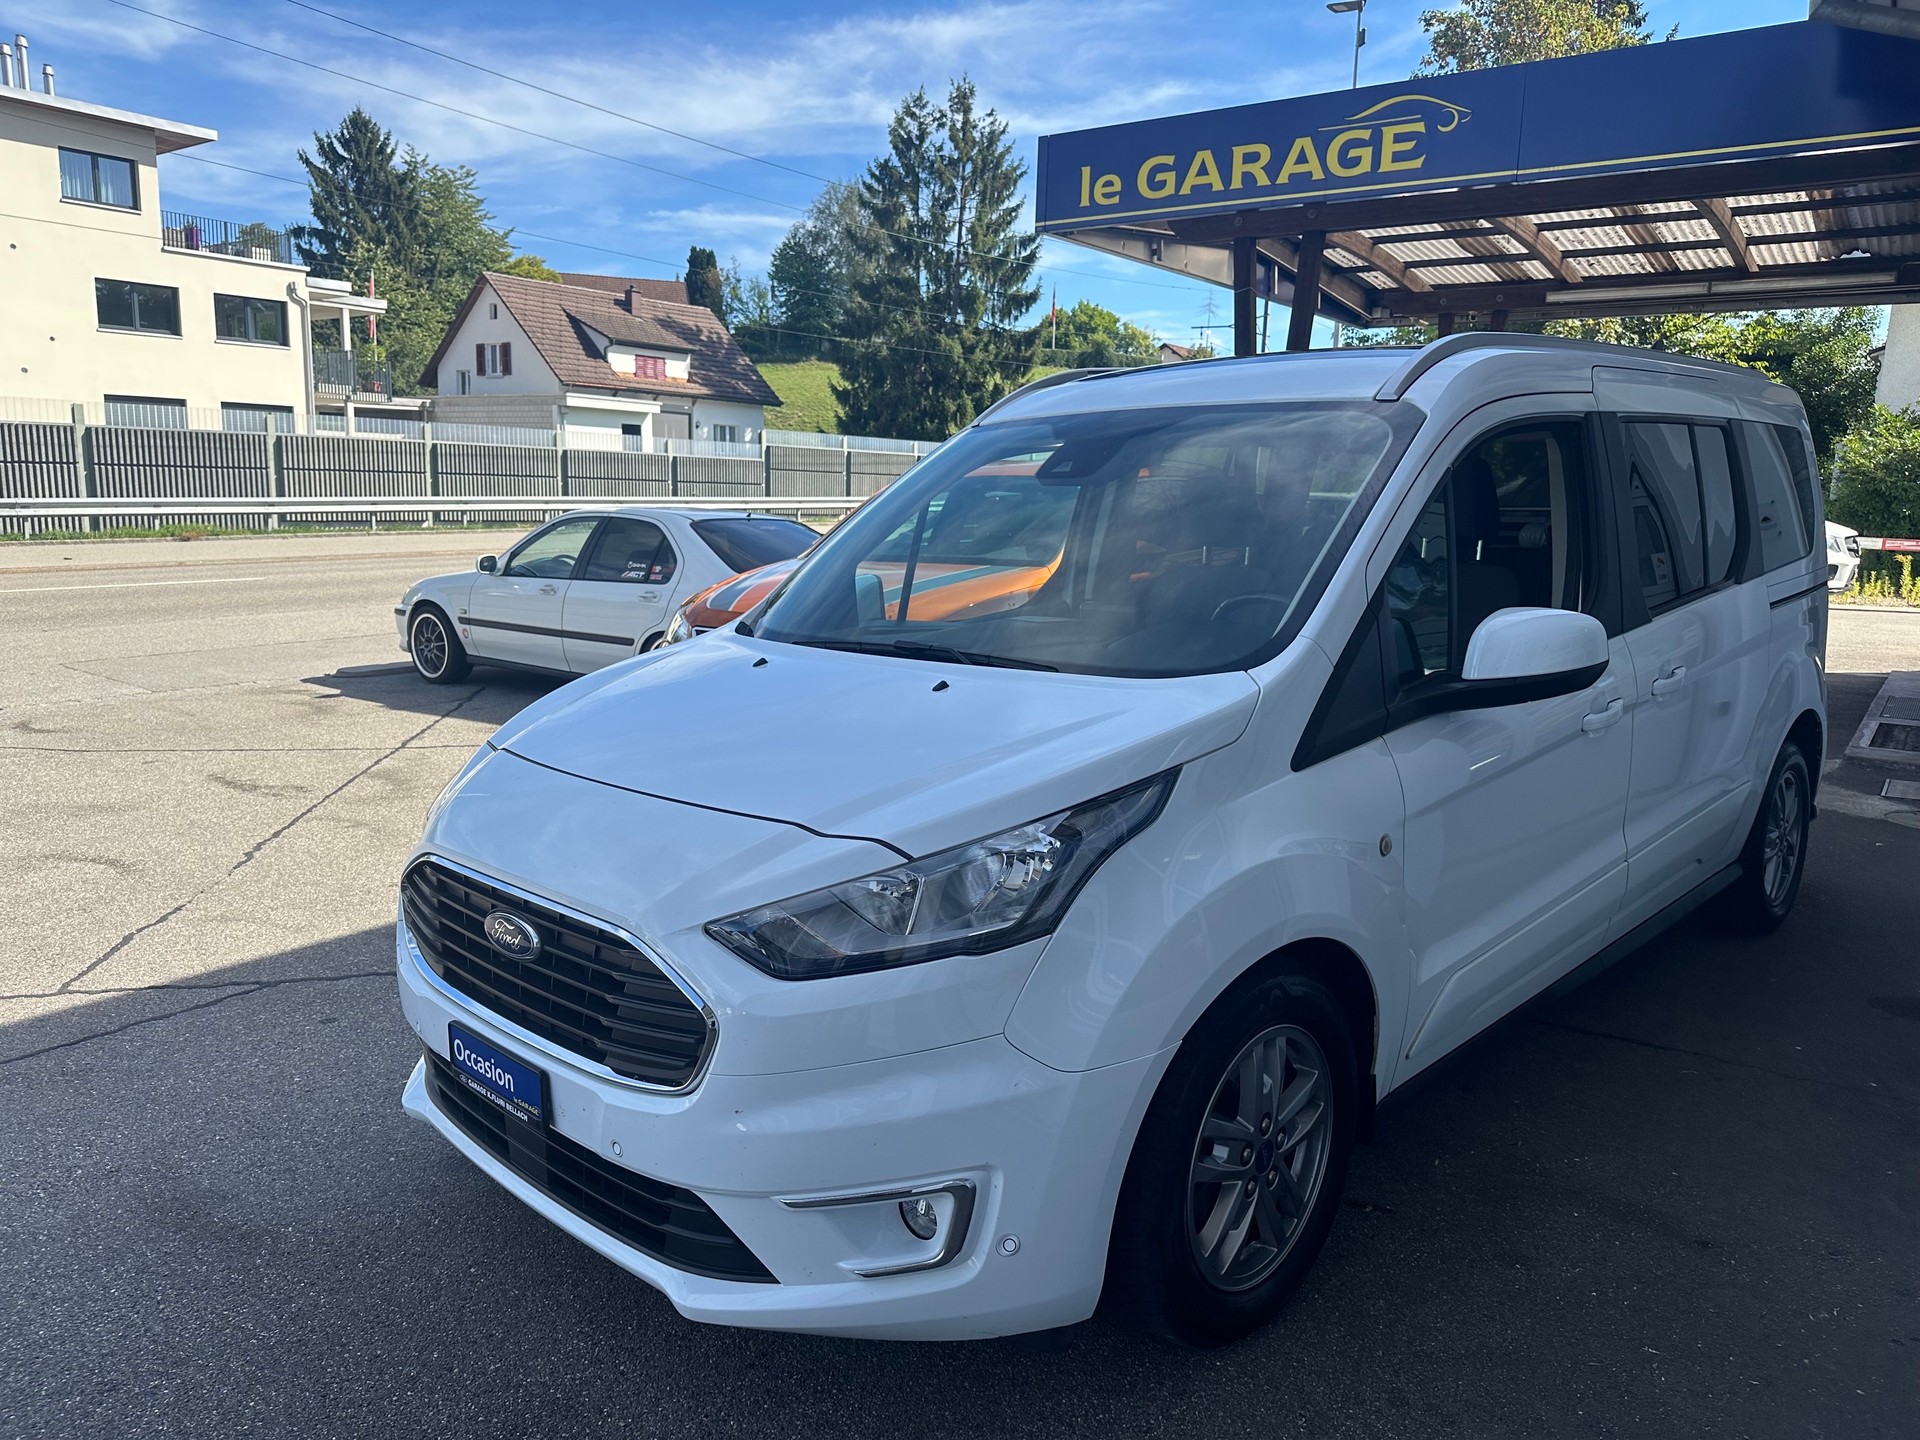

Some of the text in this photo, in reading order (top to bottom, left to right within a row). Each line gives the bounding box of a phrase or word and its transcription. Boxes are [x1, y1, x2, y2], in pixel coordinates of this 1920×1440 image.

[1079, 121, 1426, 207] le GARAGE
[491, 918, 522, 950] Ford
[453, 1038, 514, 1092] Occasion
[468, 1079, 487, 1096] GARAGE
[506, 1102, 528, 1122] BELLACH
